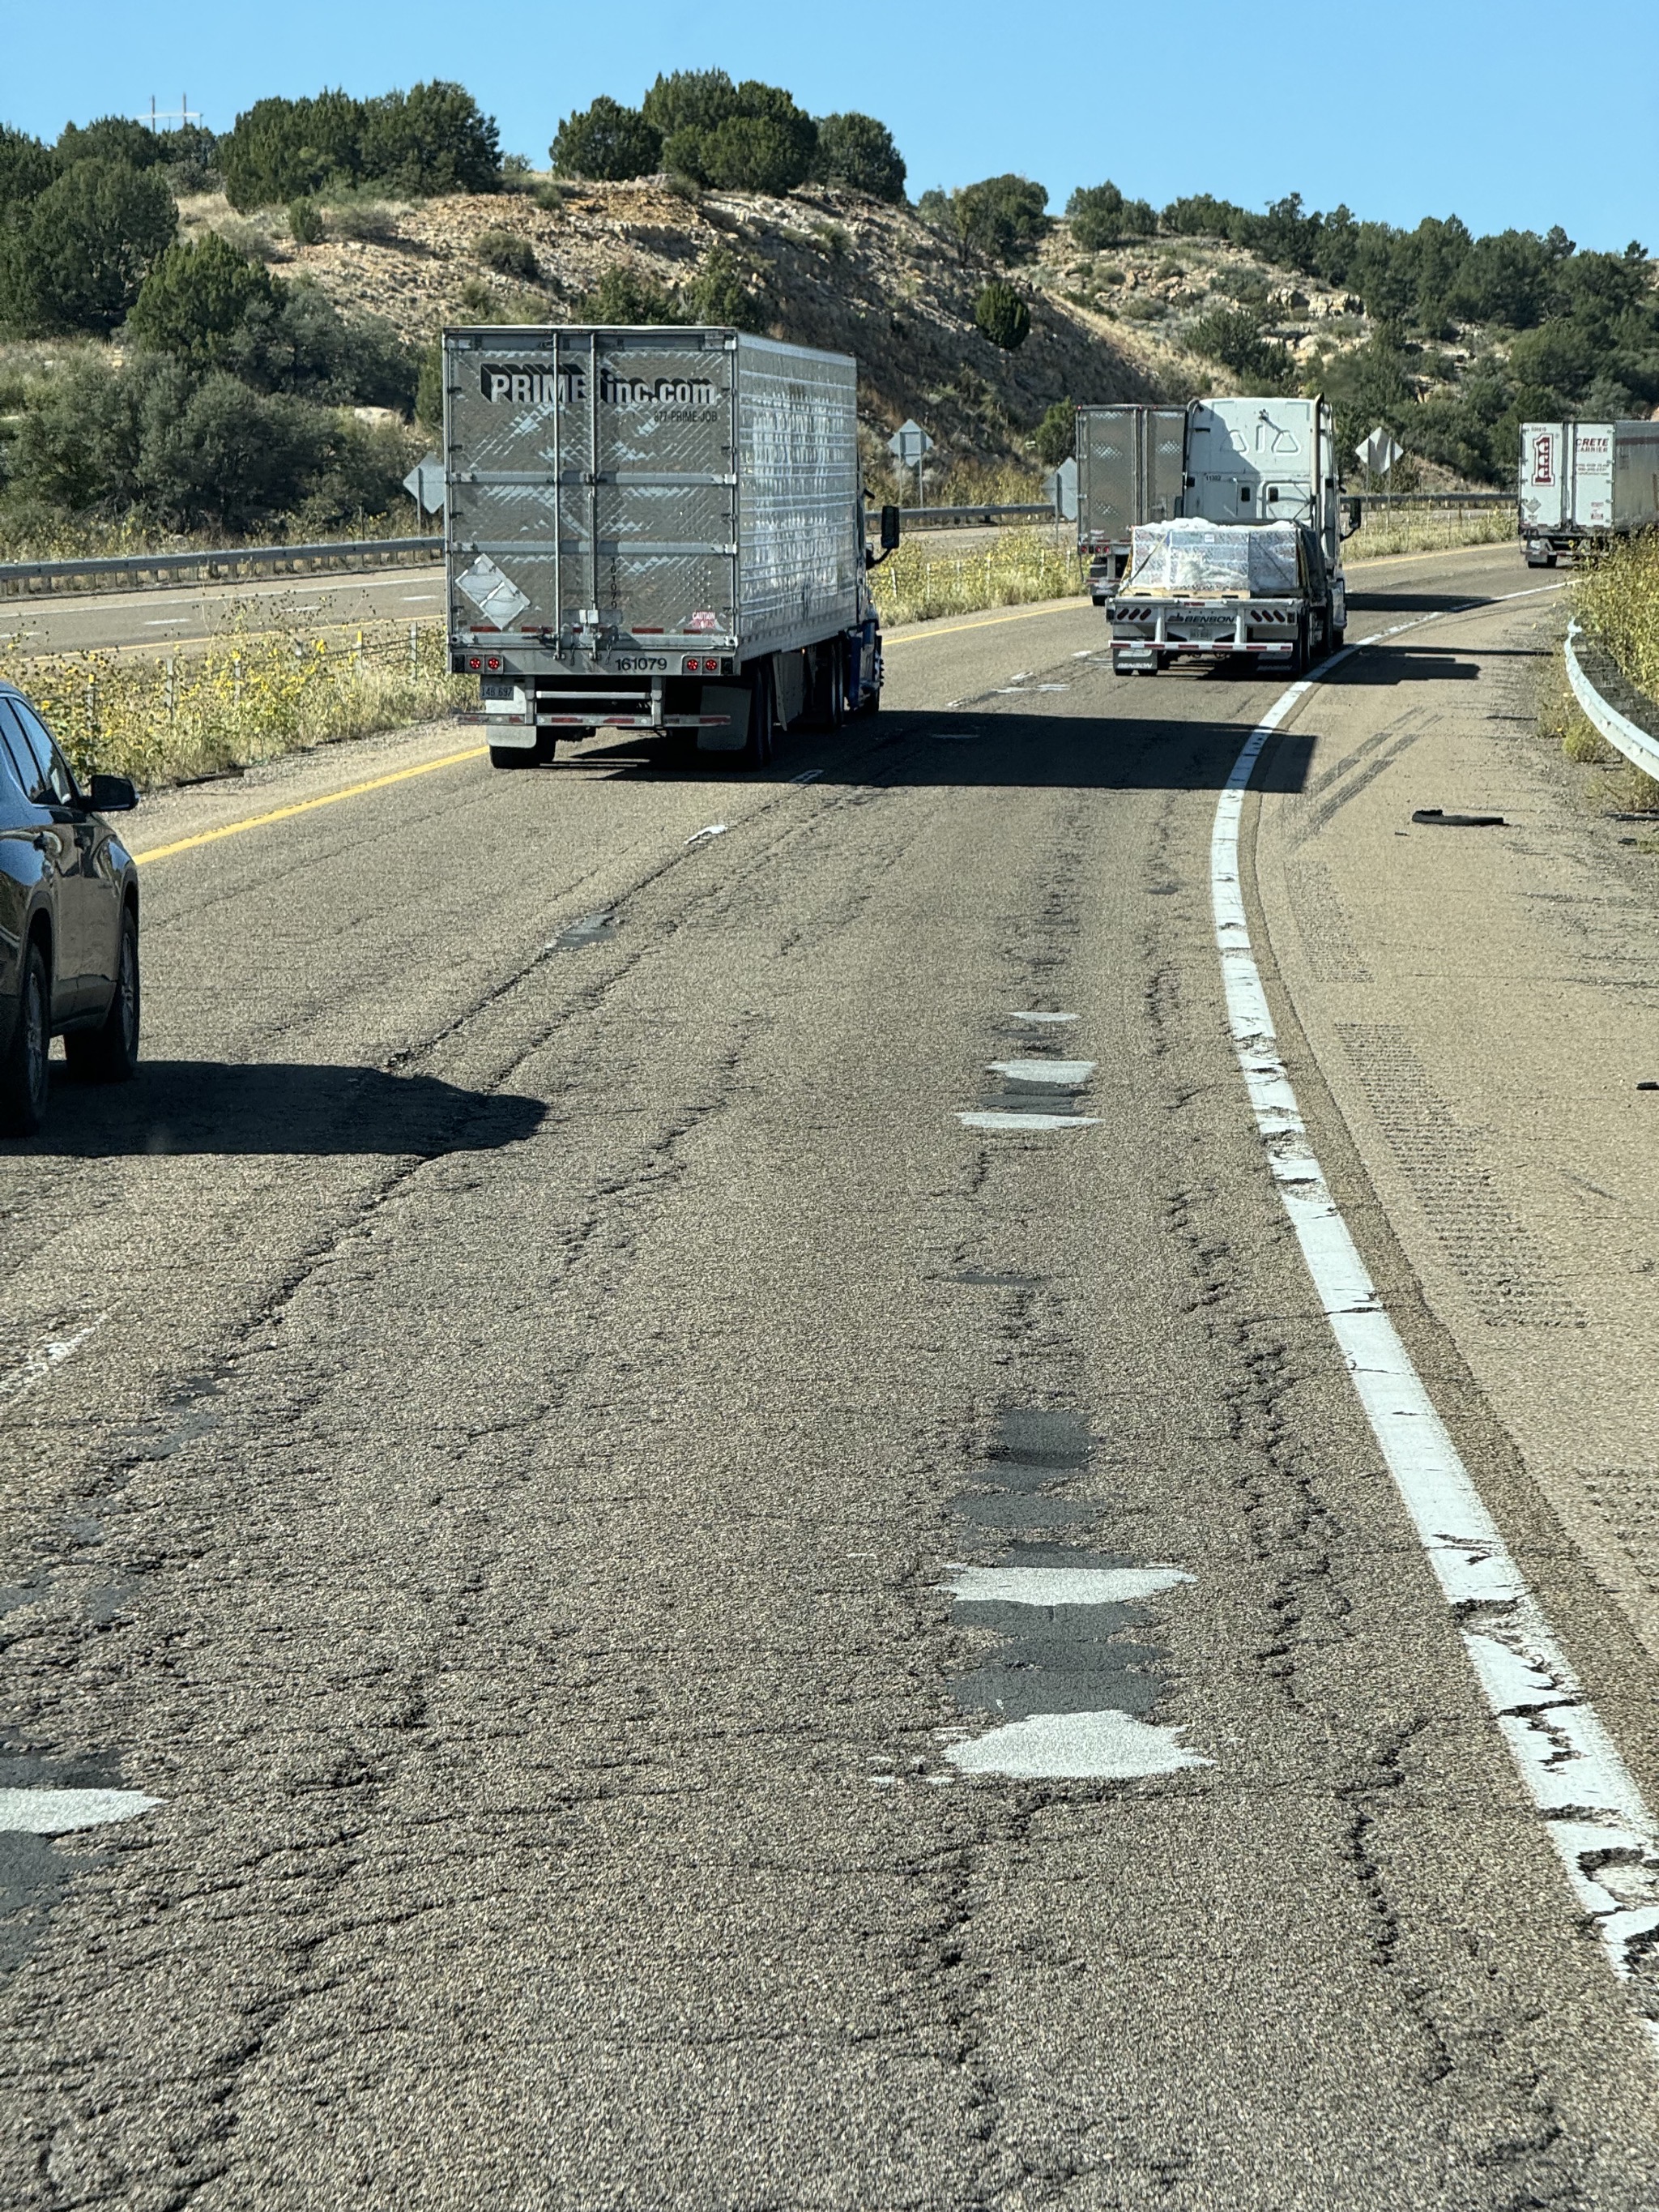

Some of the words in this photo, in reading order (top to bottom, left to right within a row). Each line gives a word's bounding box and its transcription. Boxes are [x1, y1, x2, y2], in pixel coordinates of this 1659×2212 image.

[481, 364, 587, 404] PRIME
[600, 368, 717, 404] inc.com
[654, 411, 718, 422] 877-PRIME-JOB
[1576, 438, 1609, 446] CRETE
[692, 612, 715, 620] CAUTION
[616, 657, 667, 671] 161079
